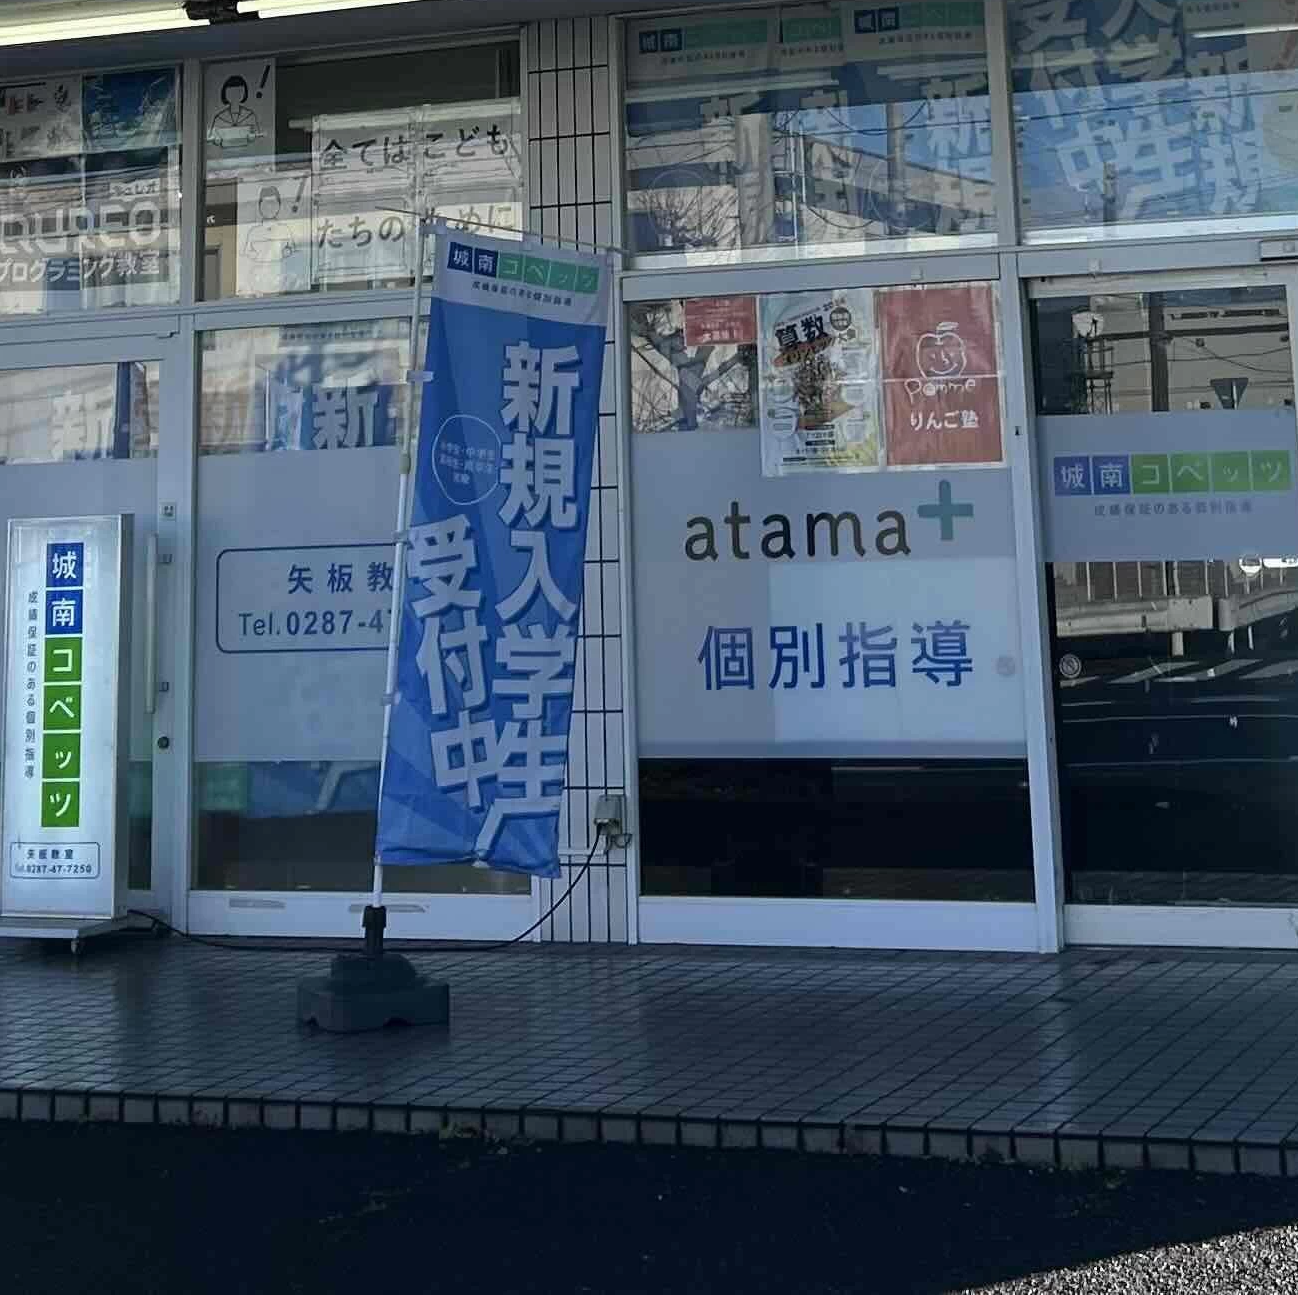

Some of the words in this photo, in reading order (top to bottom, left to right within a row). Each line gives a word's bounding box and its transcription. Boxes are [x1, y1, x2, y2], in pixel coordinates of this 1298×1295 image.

[1061, 460, 1282, 490] 城南コベッツ
[228, 608, 393, 637] Tel.0287-4
[696, 619, 974, 692] 個別指導
[48, 550, 79, 818] 城南コベッツ
[404, 513, 498, 809] 受付中
